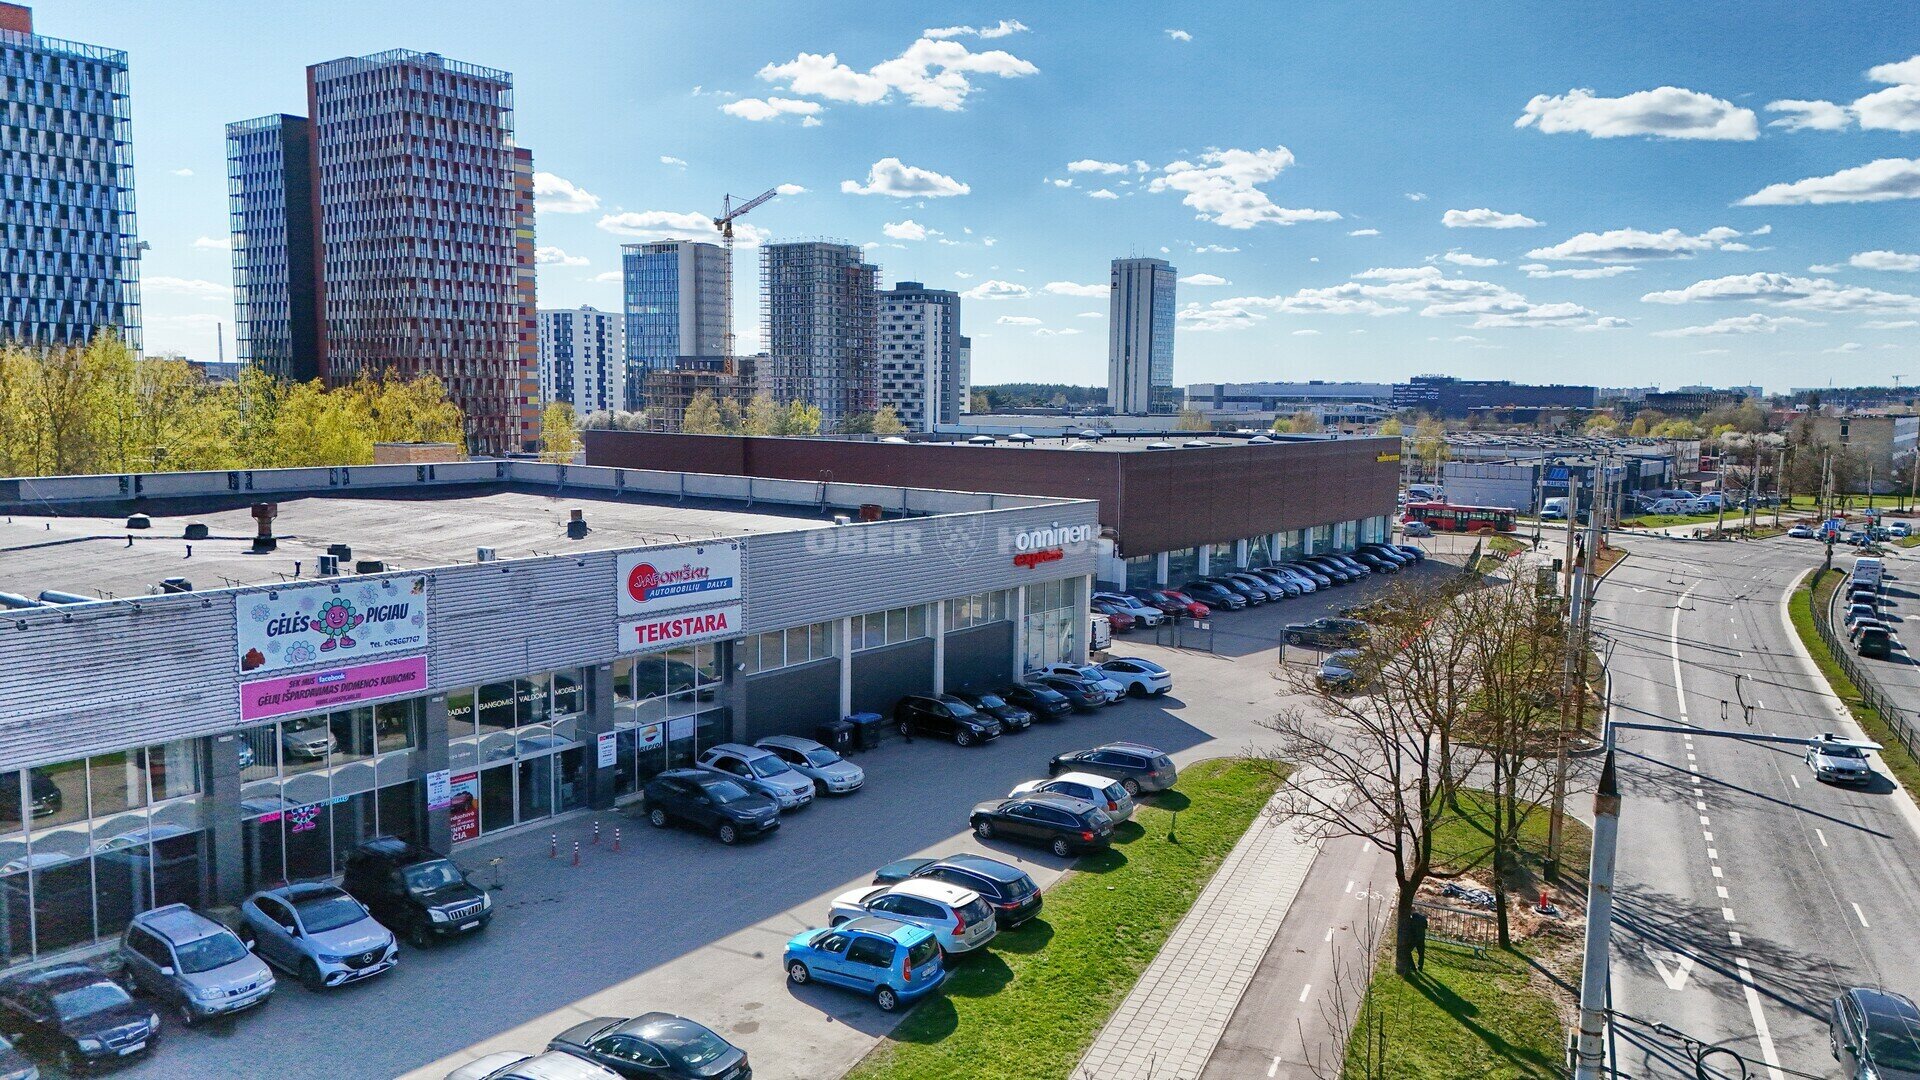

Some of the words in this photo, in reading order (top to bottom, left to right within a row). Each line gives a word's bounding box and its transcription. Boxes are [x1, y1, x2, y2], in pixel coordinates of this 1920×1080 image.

[1015, 521, 1092, 551] onninen
[1013, 548, 1064, 569] express
[649, 583, 701, 597] AUTOMOBILIŲ
[706, 579, 727, 589] DALYS
[266, 611, 310, 637] GĖLĖS
[365, 603, 409, 624] PIGIAU
[634, 612, 728, 644] TEKSTARA
[258, 691, 280, 707] GĖLIŲ
[281, 683, 339, 703] IŠPARDAVIMAS
[340, 678, 379, 694] DIDMENOS
[380, 671, 416, 686] KAINOMIS
[318, 674, 346, 684] facebook
[478, 697, 514, 711] BANGOMIS
[518, 691, 548, 703] VALDOMI
[554, 684, 583, 696] MODELIAI
[452, 831, 467, 841] ČIA
